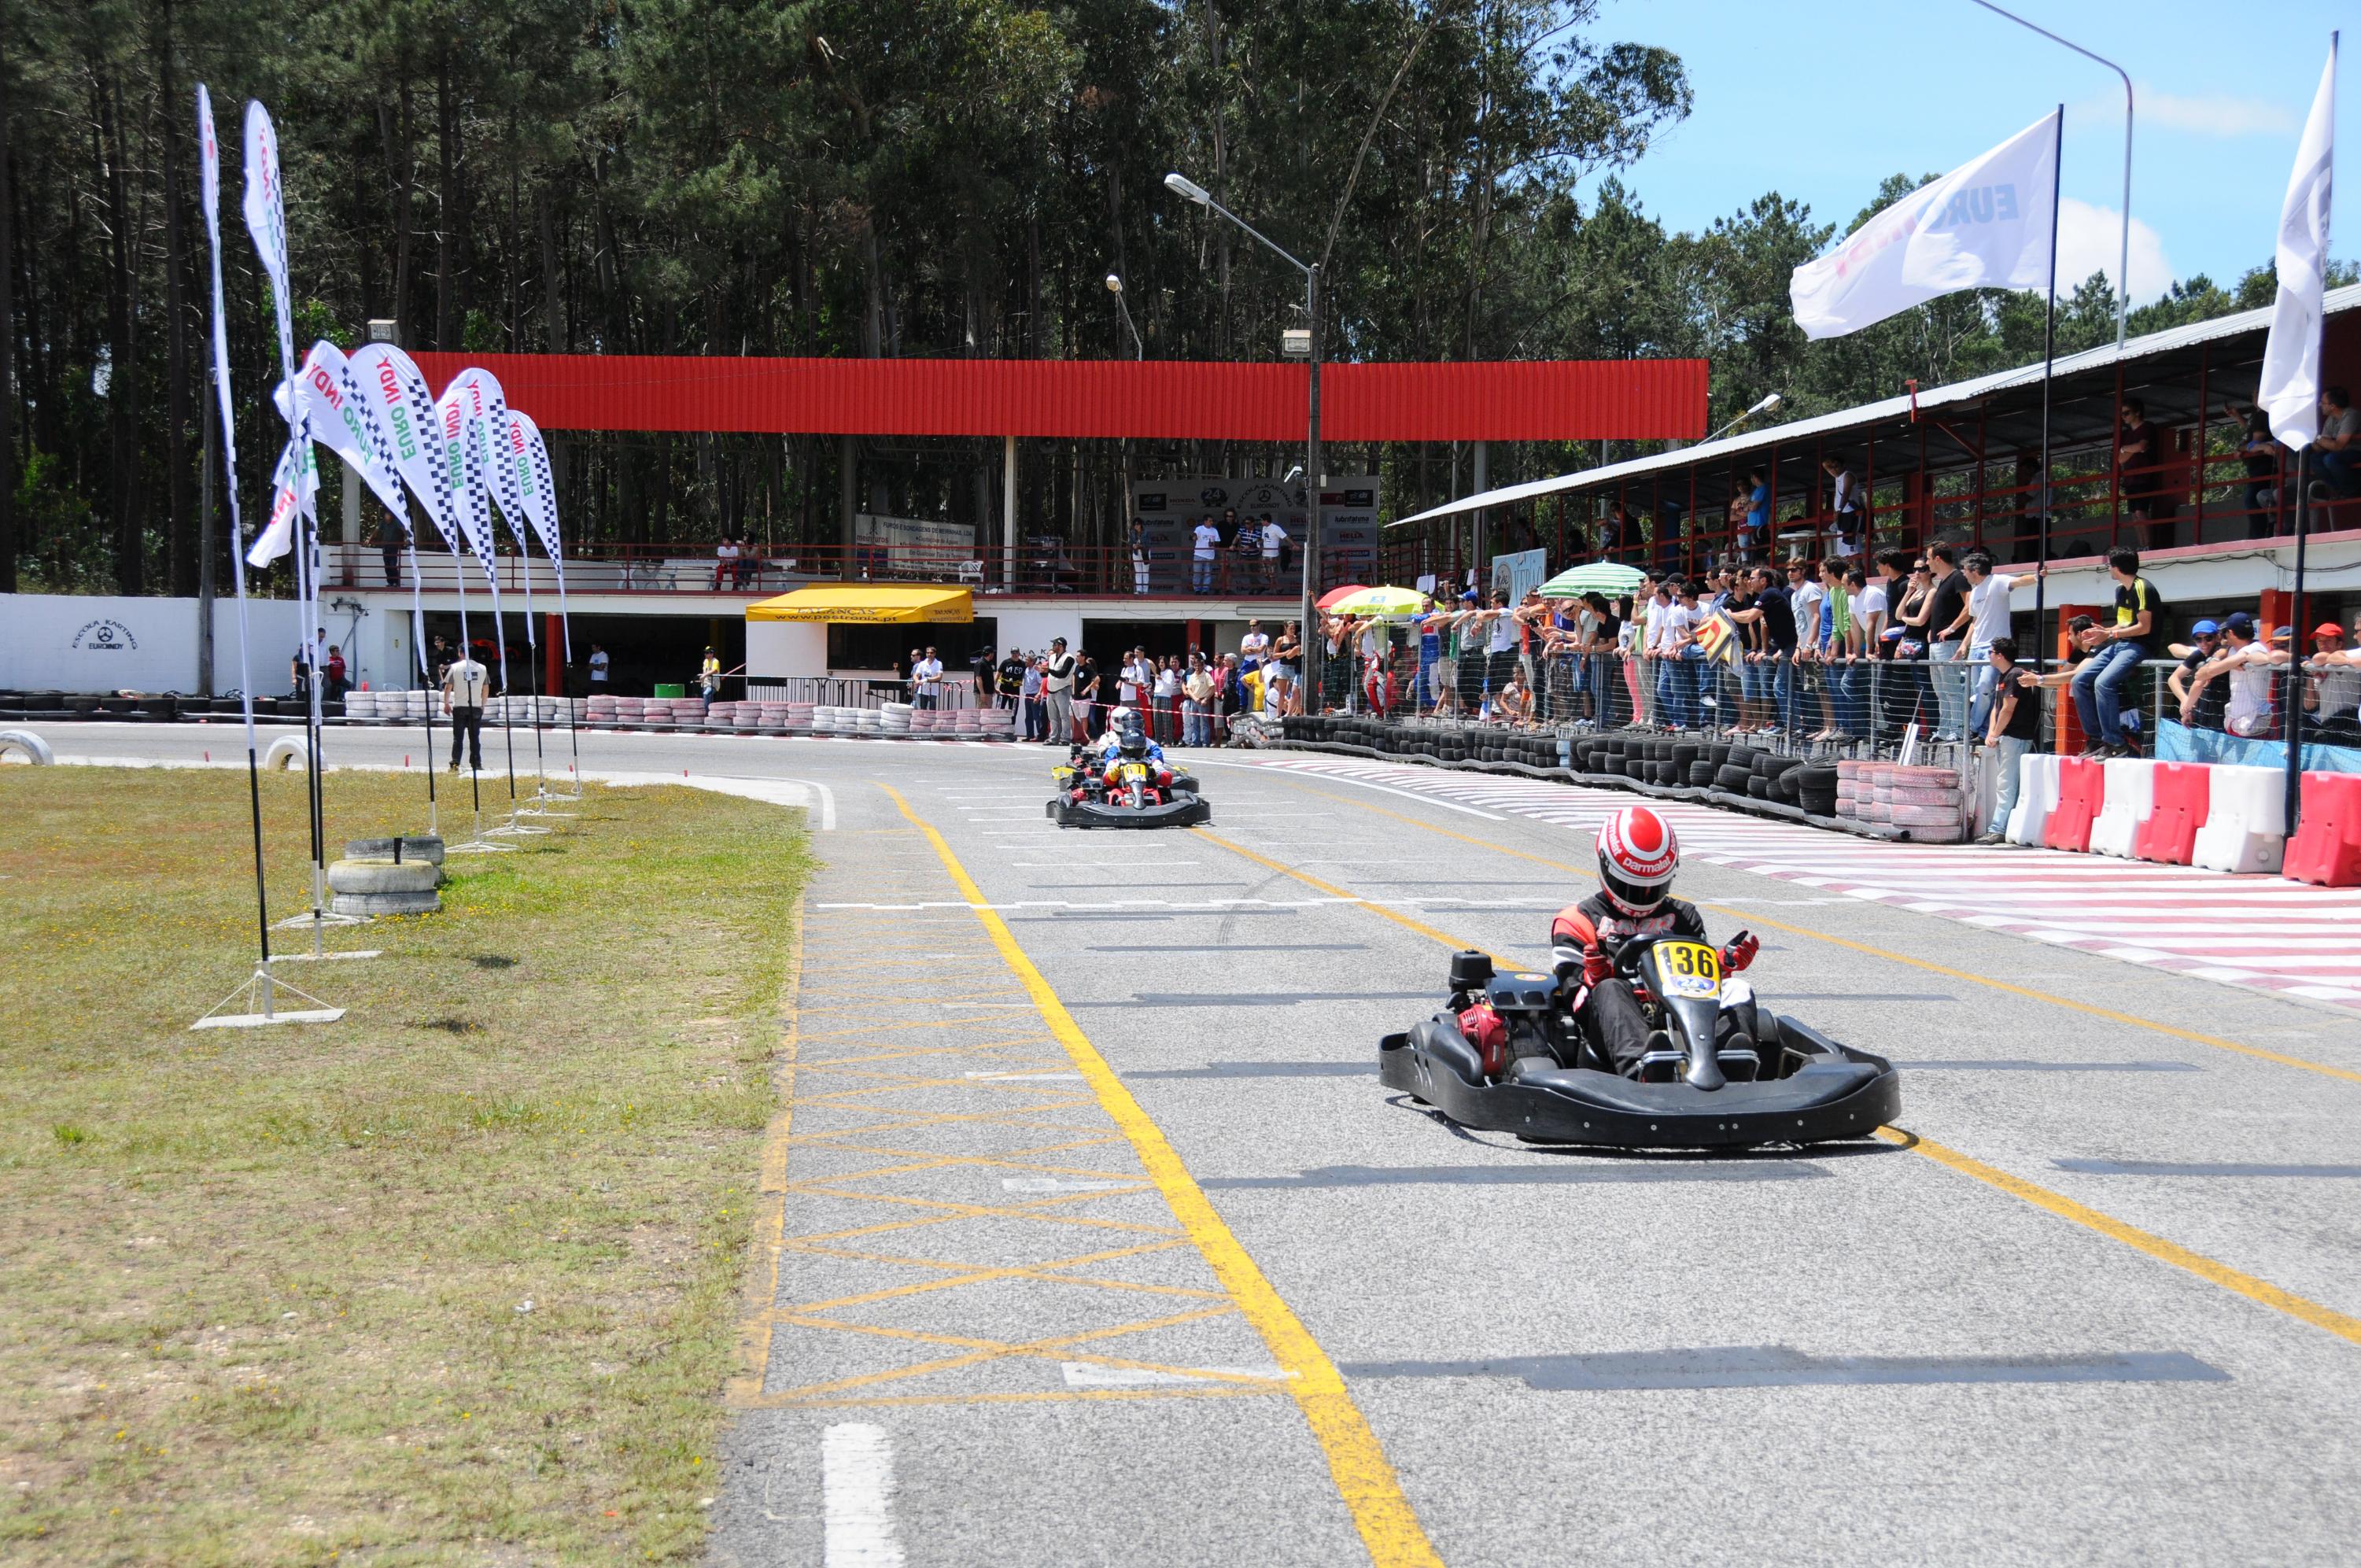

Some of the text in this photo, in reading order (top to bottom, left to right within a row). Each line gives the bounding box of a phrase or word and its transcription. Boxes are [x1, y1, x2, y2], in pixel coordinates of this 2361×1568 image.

[1237, 485, 1260, 509] ESCOLA
[1264, 483, 1293, 507] KARTING
[72, 619, 138, 650] ESCOLA KARTING
[1622, 855, 1671, 873] parmalat
[1658, 946, 1714, 978] 136
